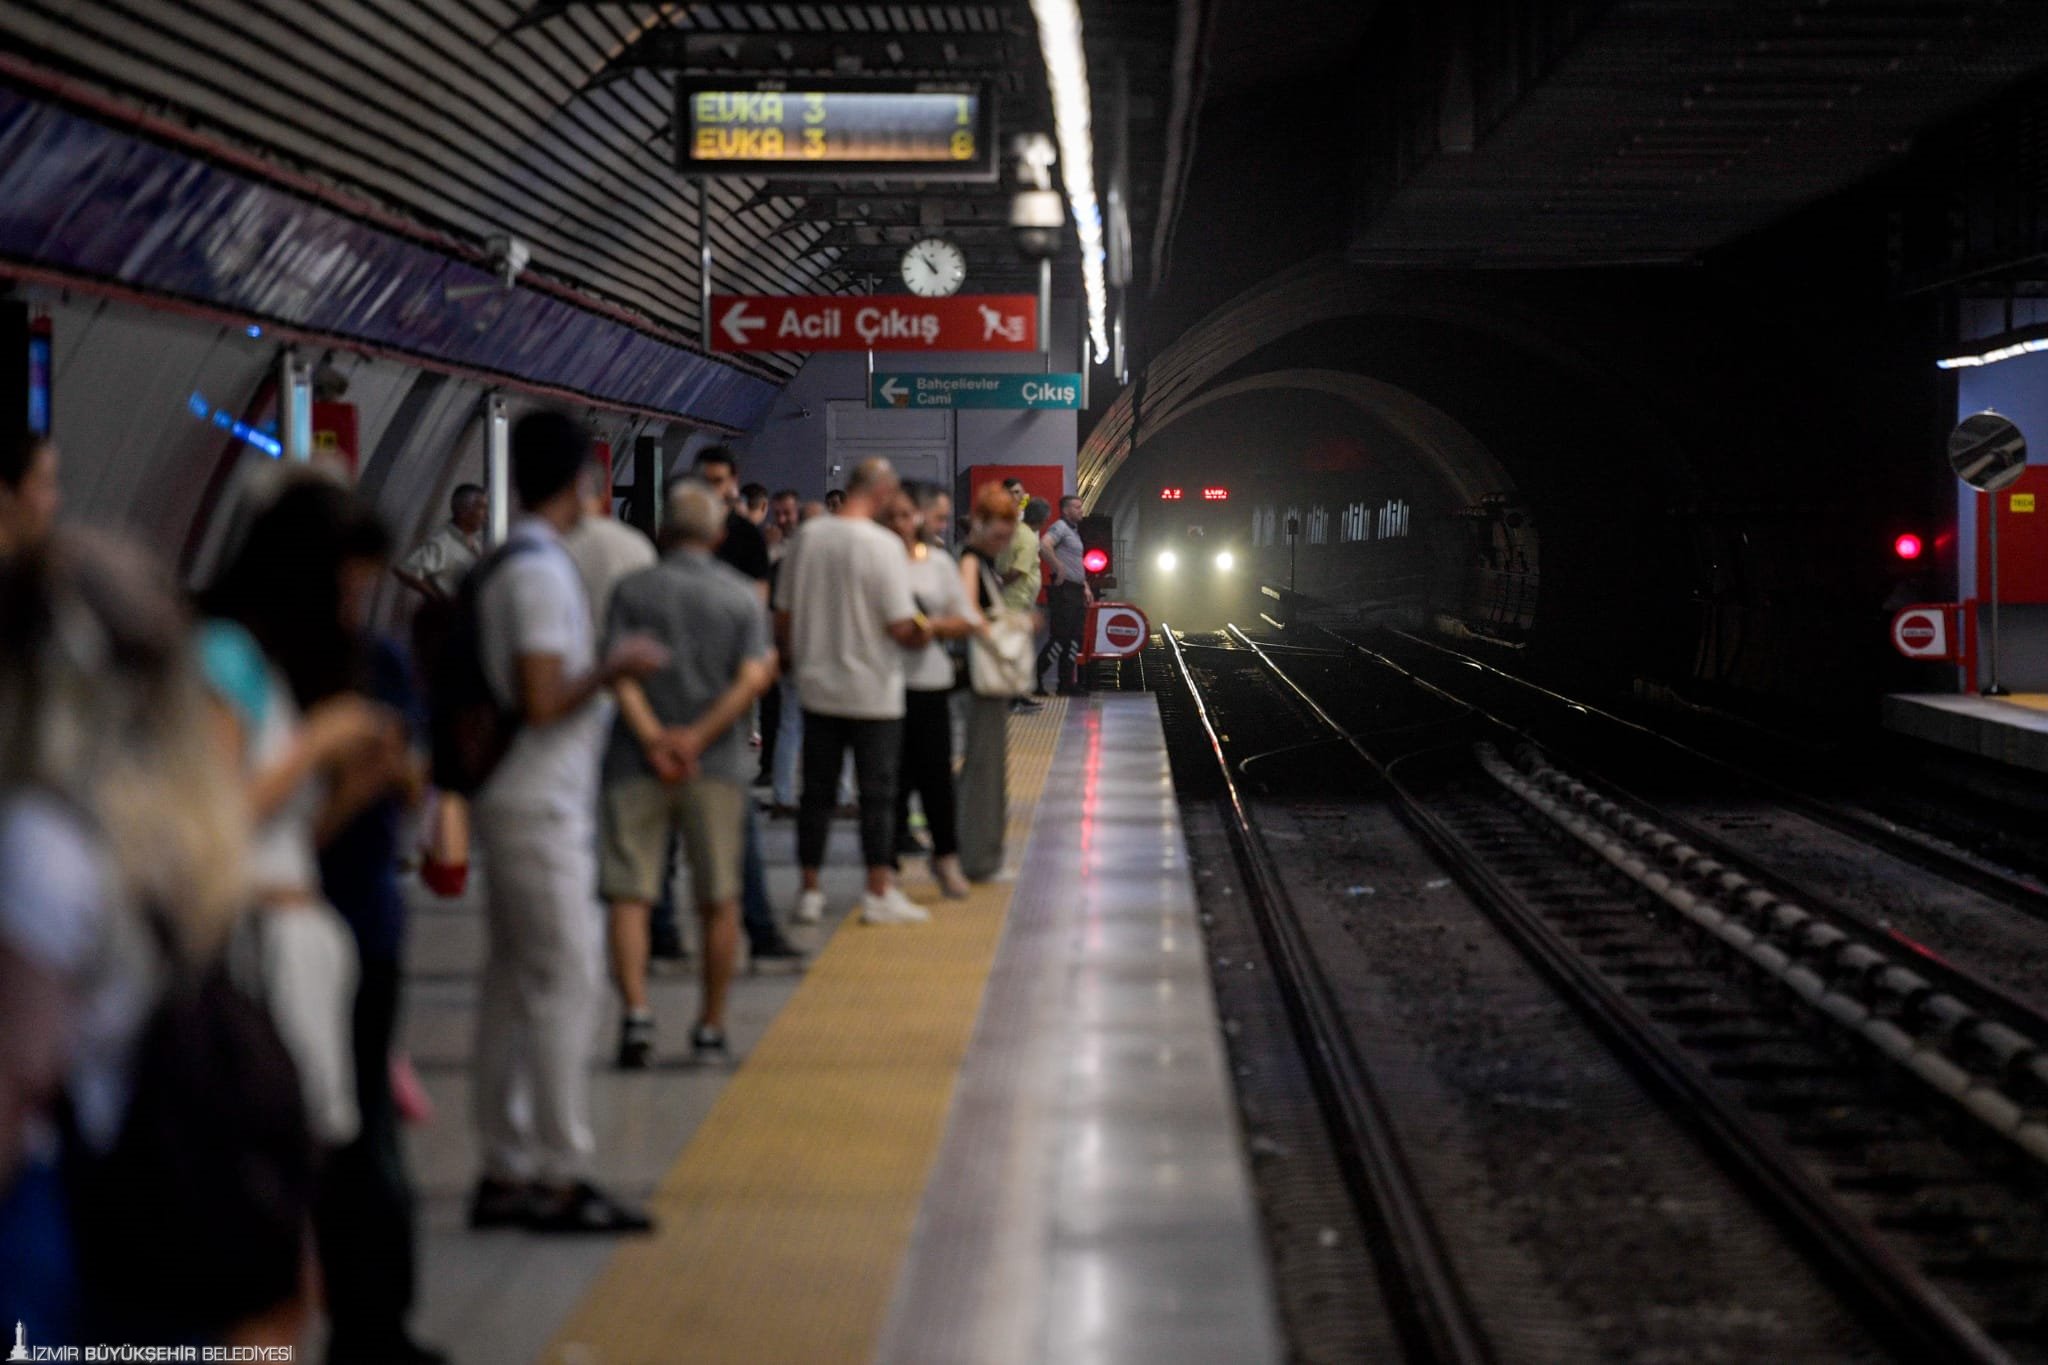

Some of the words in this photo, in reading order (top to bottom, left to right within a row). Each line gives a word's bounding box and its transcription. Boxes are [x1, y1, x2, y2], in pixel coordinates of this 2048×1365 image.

[804, 91, 827, 123] 3
[956, 94, 969, 125] 1
[696, 127, 784, 160] EVKA
[804, 127, 827, 159] 3
[777, 307, 842, 339] Acil
[854, 306, 941, 345] Çıkış
[916, 377, 1000, 393] Bahçelievler
[916, 393, 952, 405] Cami
[1021, 382, 1076, 405] Çıkış
